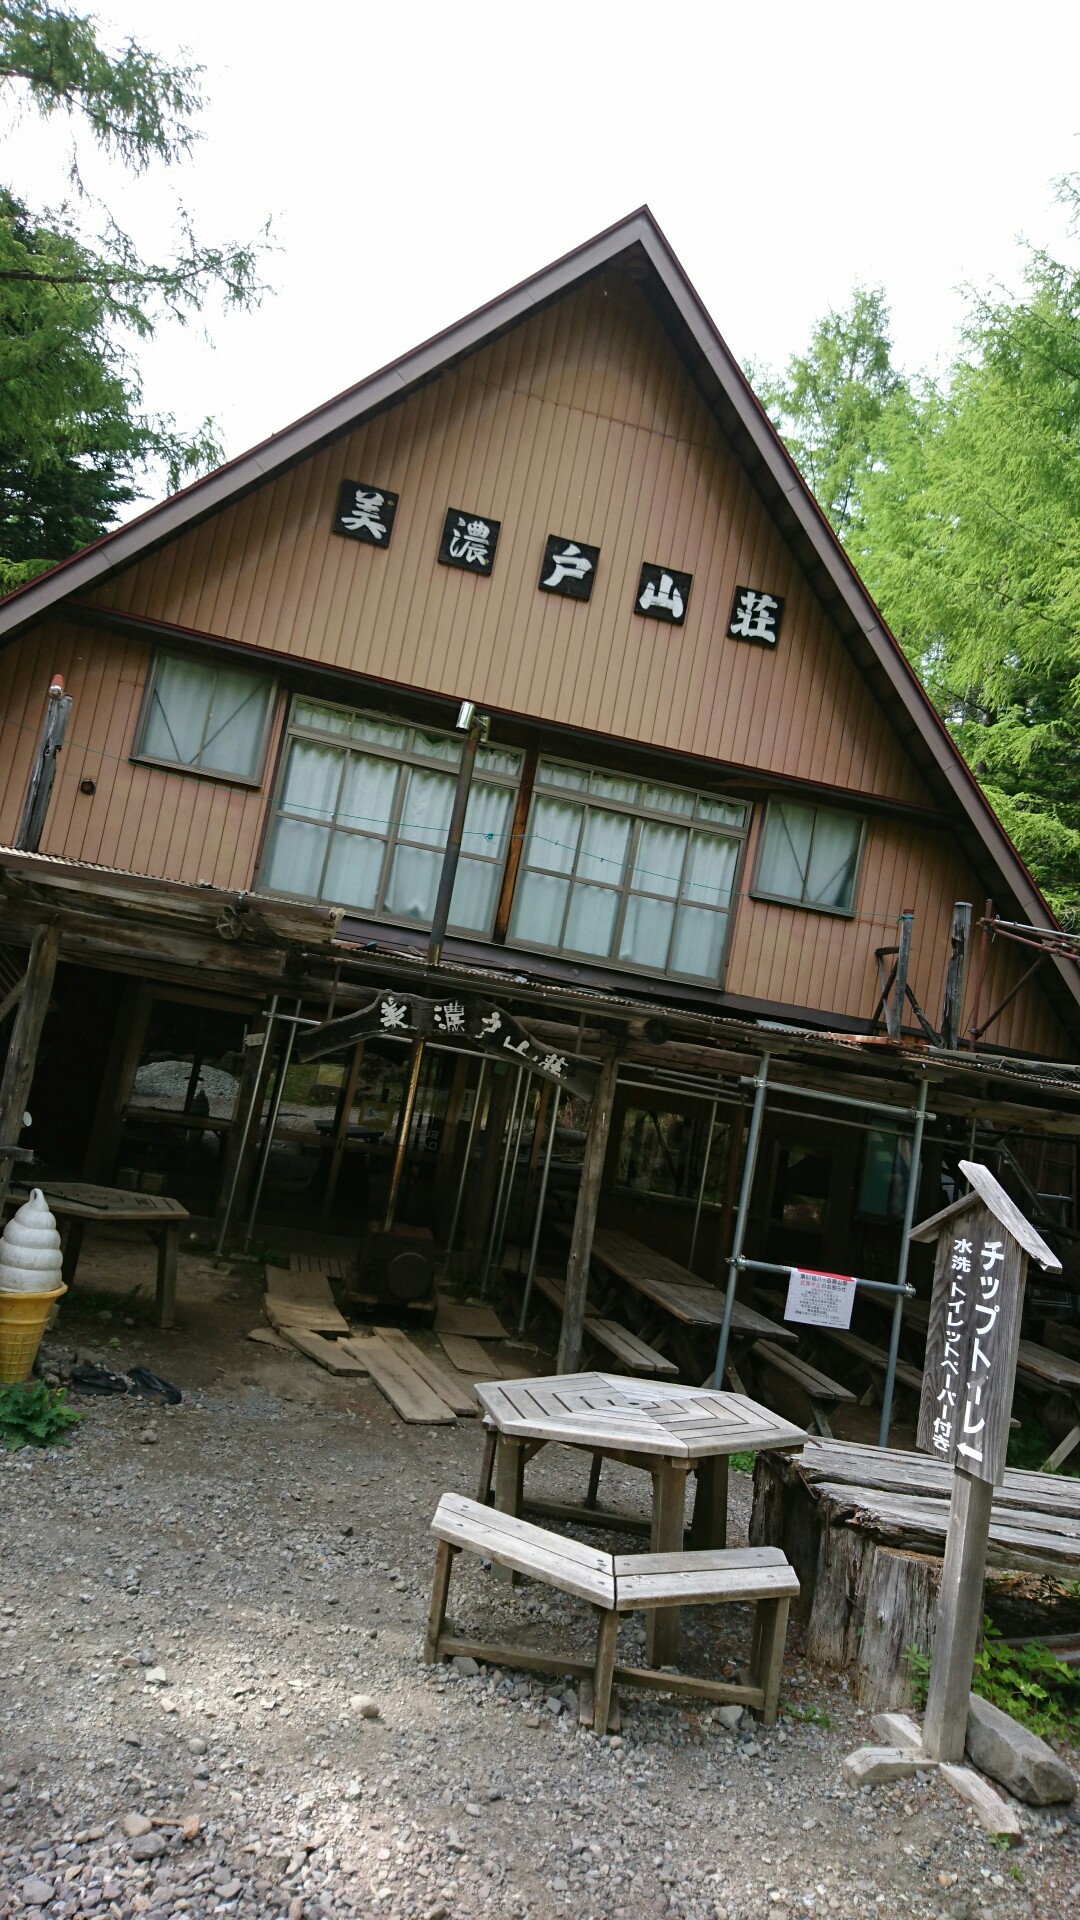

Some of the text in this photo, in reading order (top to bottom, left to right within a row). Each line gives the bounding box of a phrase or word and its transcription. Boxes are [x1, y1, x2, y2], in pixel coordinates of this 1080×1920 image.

[341, 489, 777, 643] 美濃戸山荘
